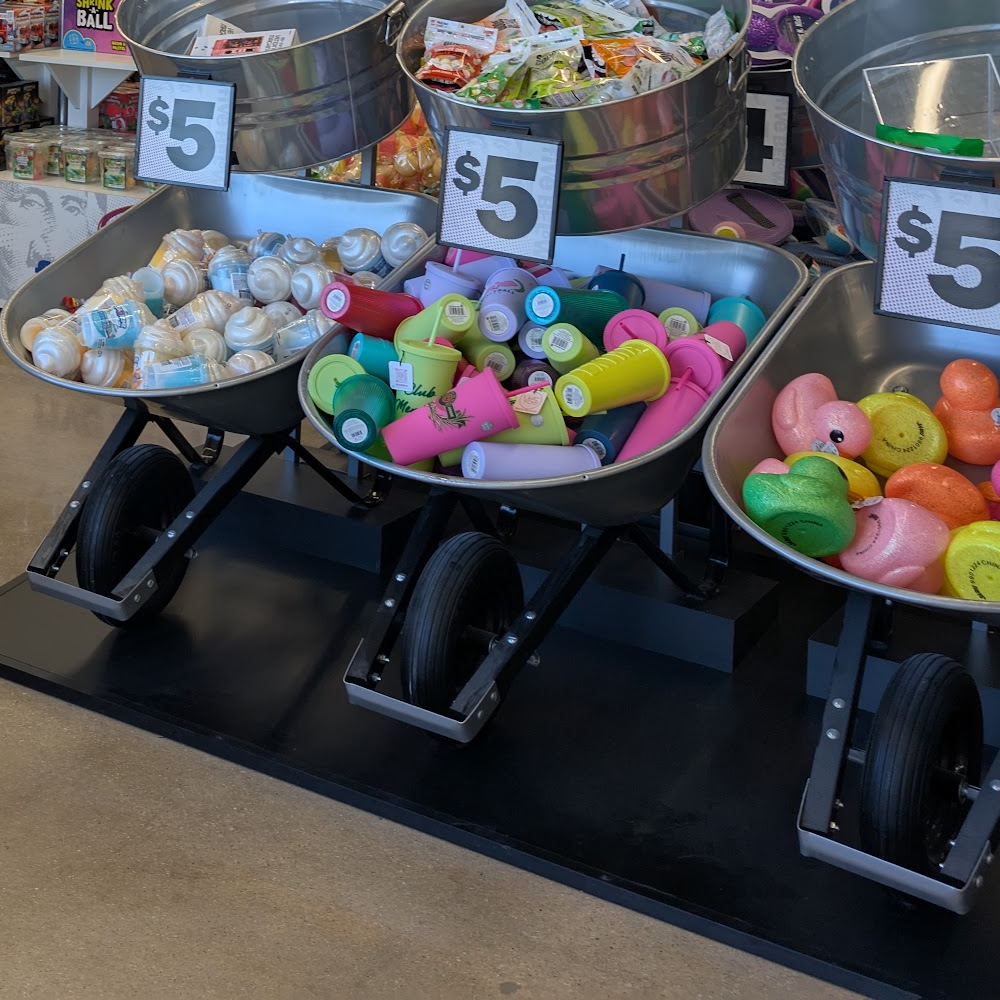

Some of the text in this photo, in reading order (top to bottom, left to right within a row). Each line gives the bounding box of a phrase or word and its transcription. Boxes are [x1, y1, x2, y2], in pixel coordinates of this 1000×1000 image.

[76, 9, 113, 31] BALL
[146, 96, 216, 172] $5
[453, 150, 539, 240] $5
[894, 205, 1000, 310] $5
